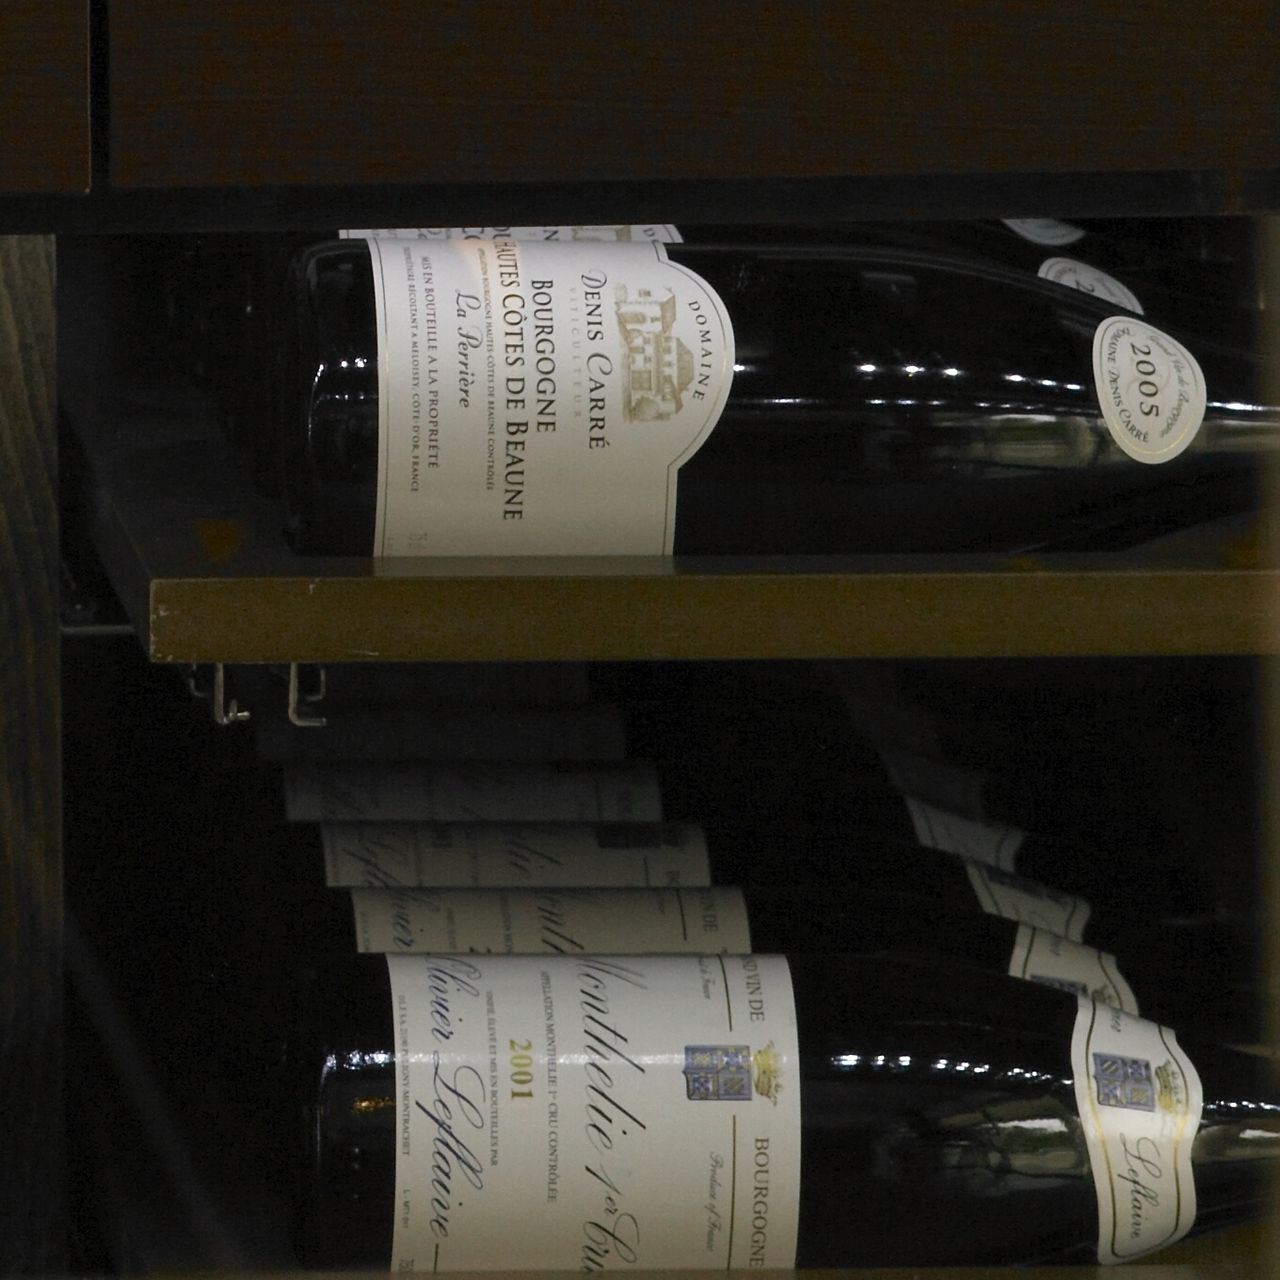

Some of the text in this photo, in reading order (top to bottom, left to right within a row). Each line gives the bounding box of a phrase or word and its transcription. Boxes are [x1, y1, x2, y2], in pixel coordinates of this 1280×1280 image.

[425, 286, 438, 351] BOUTEILLE
[454, 288, 483, 318] La
[501, 293, 528, 368] CÔTES
[427, 368, 438, 385] LA
[456, 324, 484, 409] Perrière
[530, 278, 558, 434] BOURGOGNE
[581, 268, 614, 451] DENIS CARRÉ
[688, 300, 714, 402] DOMAINE
[1129, 341, 1160, 418] 2005
[427, 389, 441, 469] PROPRIÉTÉ
[502, 376, 526, 412] DE
[502, 419, 529, 522] BEAUNE
[748, 999, 765, 1022] DE
[508, 1038, 534, 1102] 2001
[414, 1049, 486, 1240] Leflaive
[489, 1089, 500, 1147] BOUTEILLES
[546, 1101, 559, 1129] CRU
[489, 1149, 500, 1167] PAR
[546, 1130, 561, 1203] CONTRÔLÉE
[1118, 1133, 1162, 1242] Leflaive
[748, 1136, 771, 1266] BOURGOGNE
